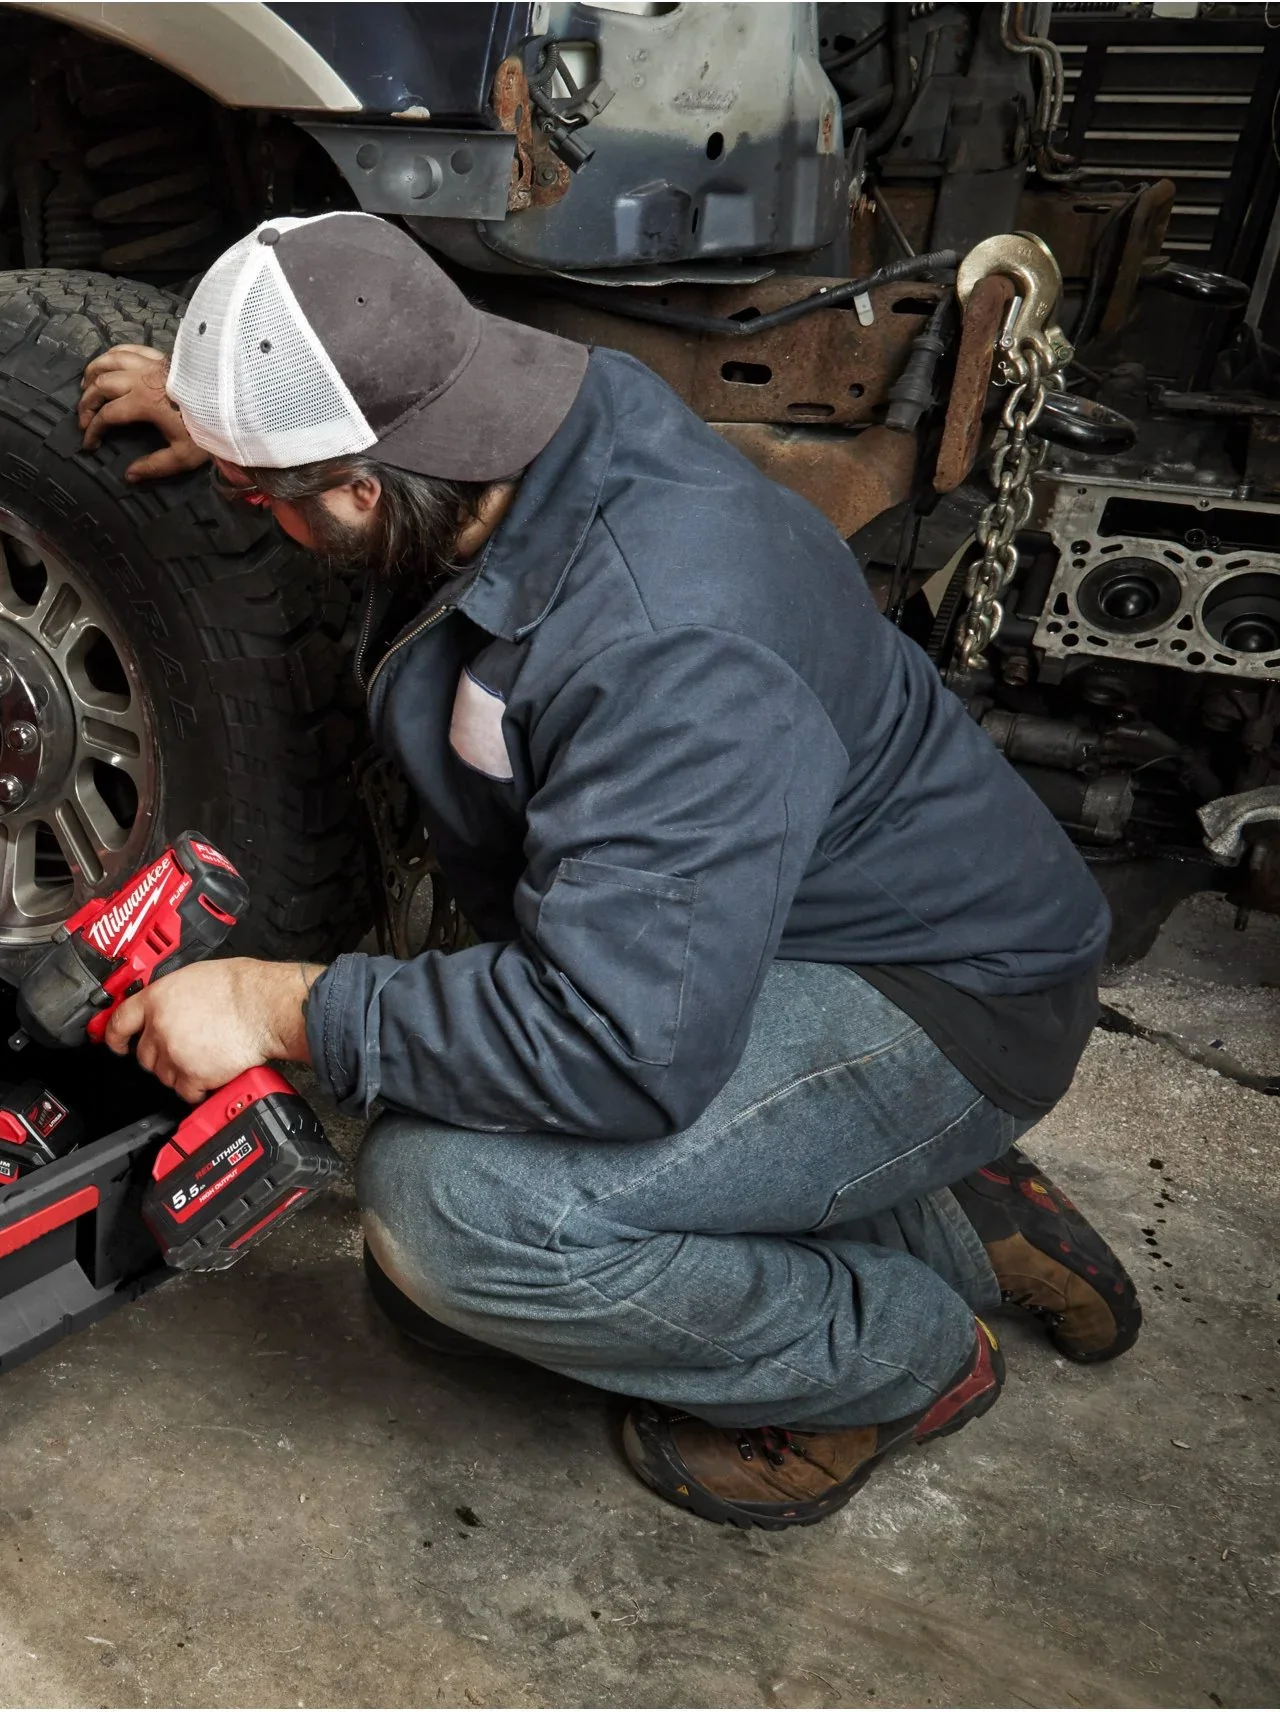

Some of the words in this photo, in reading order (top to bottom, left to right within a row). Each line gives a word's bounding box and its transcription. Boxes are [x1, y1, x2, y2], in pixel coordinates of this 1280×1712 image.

[88, 857, 171, 952] Milwaukee
[169, 880, 190, 907] FUEL
[227, 1142, 253, 1166] M18
[199, 1188, 215, 1203] HIGH
[214, 1169, 238, 1189] OUTPUT
